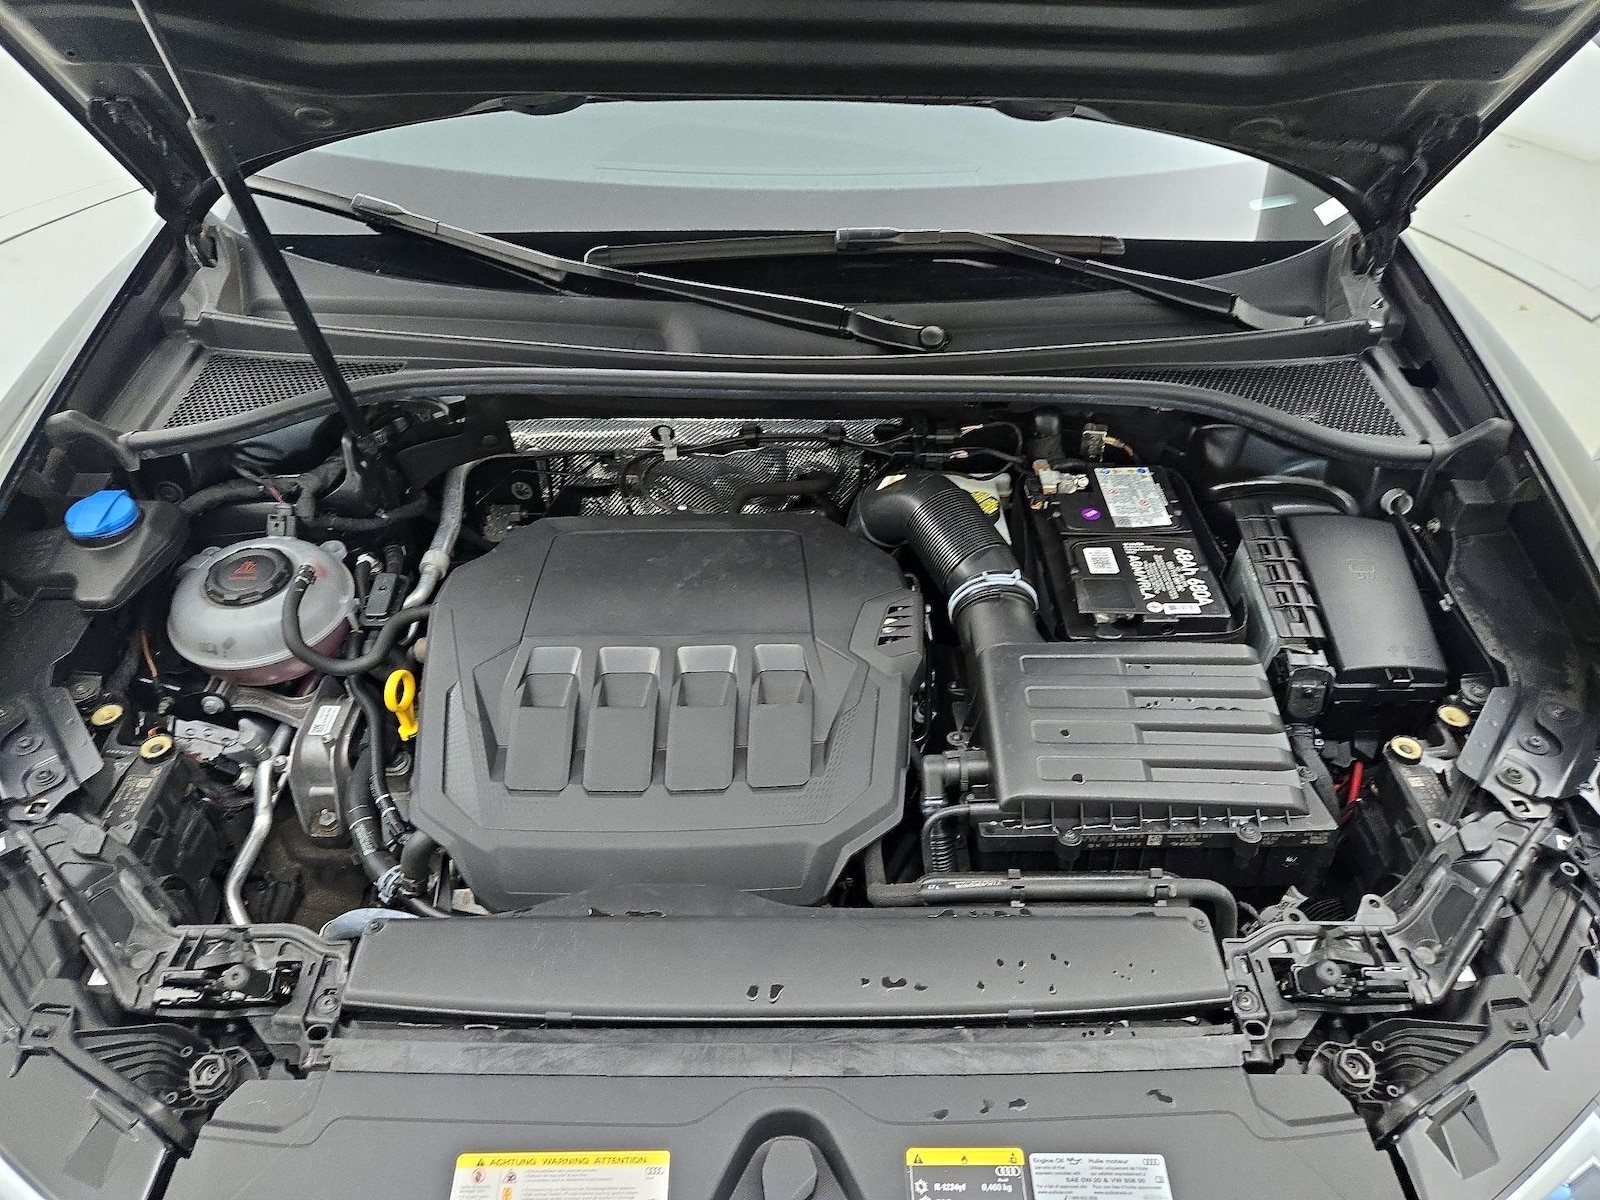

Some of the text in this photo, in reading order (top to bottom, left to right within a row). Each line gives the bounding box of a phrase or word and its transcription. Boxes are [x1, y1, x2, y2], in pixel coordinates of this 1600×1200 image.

[1173, 547, 1200, 576] 68Ah
[1186, 577, 1215, 607] 680A
[489, 1156, 648, 1167] ACHTUNG WARNING ATTENTION
[1033, 1157, 1054, 1165] Engine
